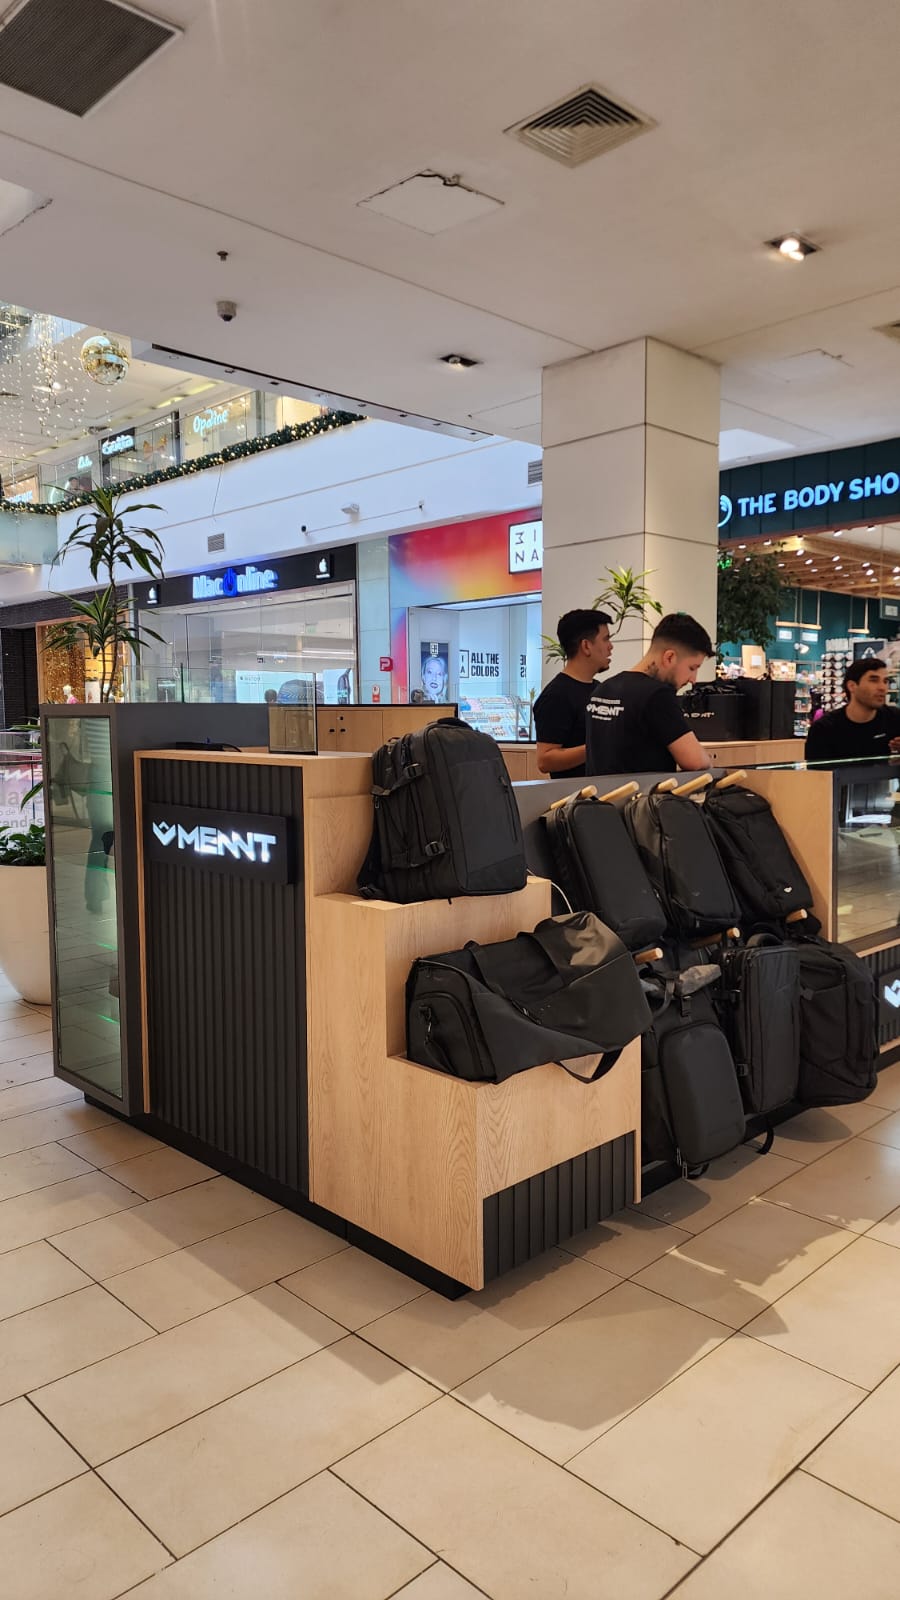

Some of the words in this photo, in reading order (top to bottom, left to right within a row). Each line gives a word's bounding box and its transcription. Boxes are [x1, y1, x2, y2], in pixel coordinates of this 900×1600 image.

[738, 493, 777, 517] THE
[784, 481, 845, 511] BODY
[849, 472, 900, 501] SHO
[470, 653, 484, 664] ALL
[486, 653, 499, 664] THE
[471, 665, 500, 677] COLORS
[177, 823, 277, 863] MENNT
